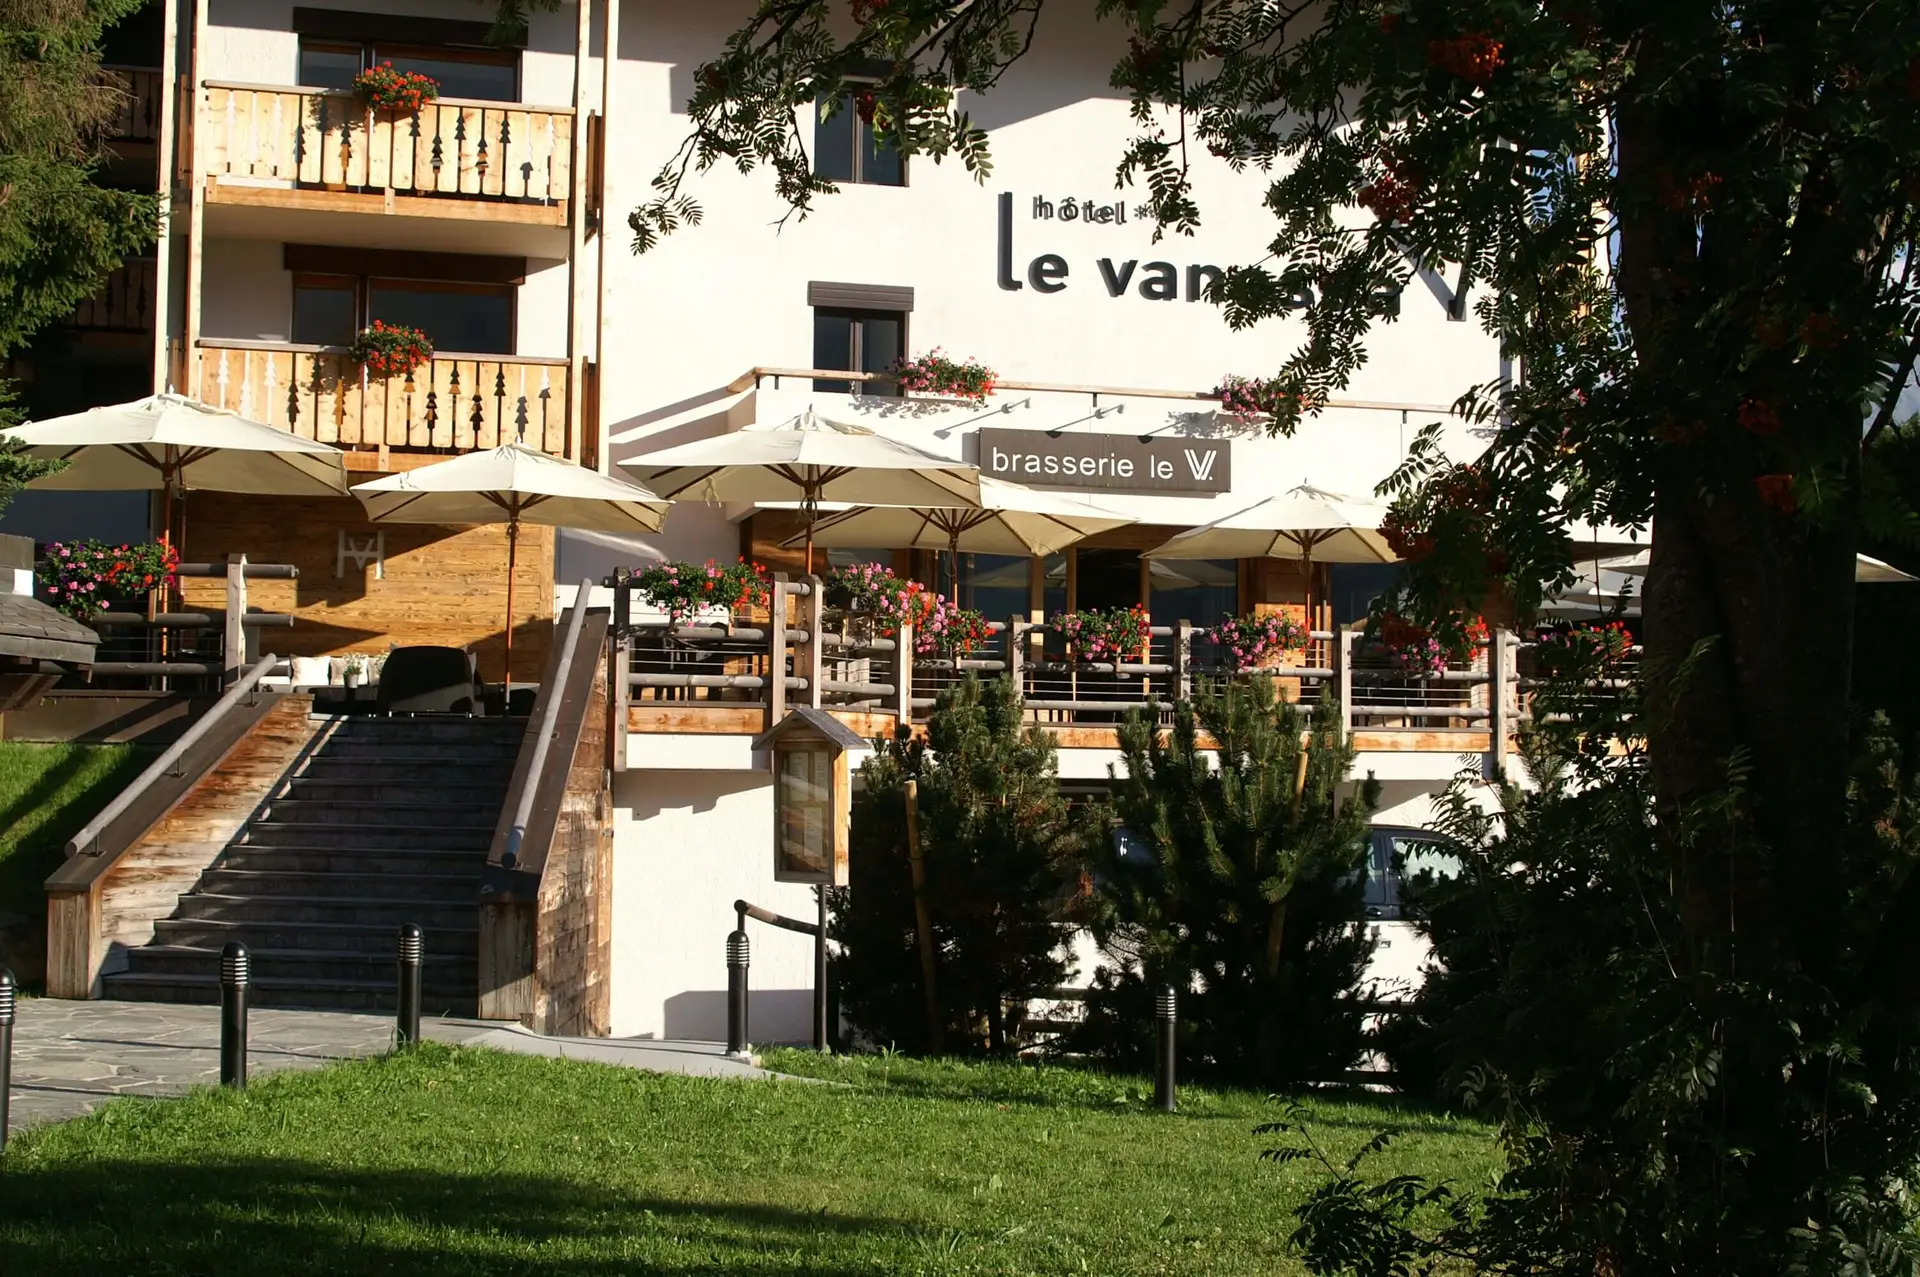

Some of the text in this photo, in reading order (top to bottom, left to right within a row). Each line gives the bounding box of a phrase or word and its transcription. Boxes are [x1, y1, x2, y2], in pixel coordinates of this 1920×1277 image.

[1033, 194, 1127, 225] hôtel
[997, 191, 1069, 294] le
[992, 446, 1134, 477] brasserie
[1150, 454, 1173, 479] le
